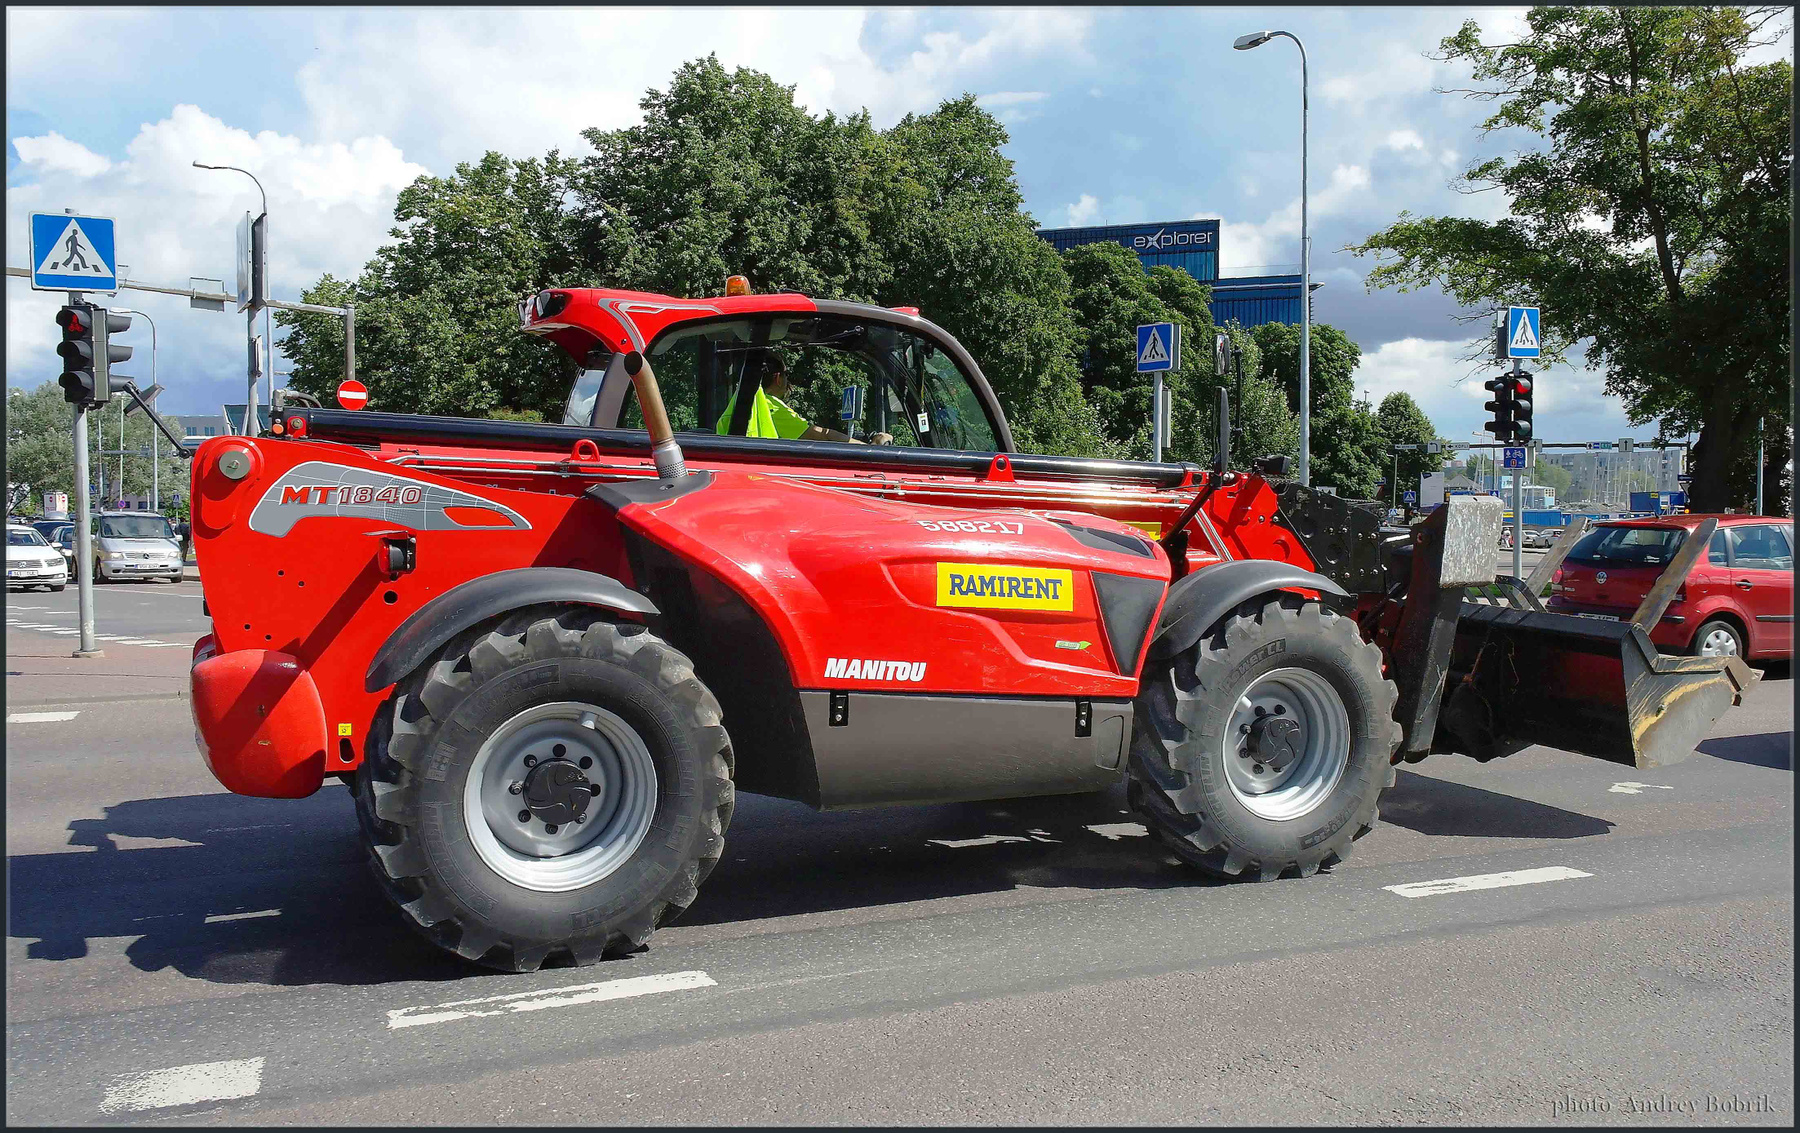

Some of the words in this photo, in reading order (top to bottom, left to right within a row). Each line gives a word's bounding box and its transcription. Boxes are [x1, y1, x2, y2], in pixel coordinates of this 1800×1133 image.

[279, 485, 421, 505] MT1840
[916, 520, 1024, 535] 588217
[949, 573, 1062, 599] RAMIRENT
[824, 657, 927, 682] MANITOU
